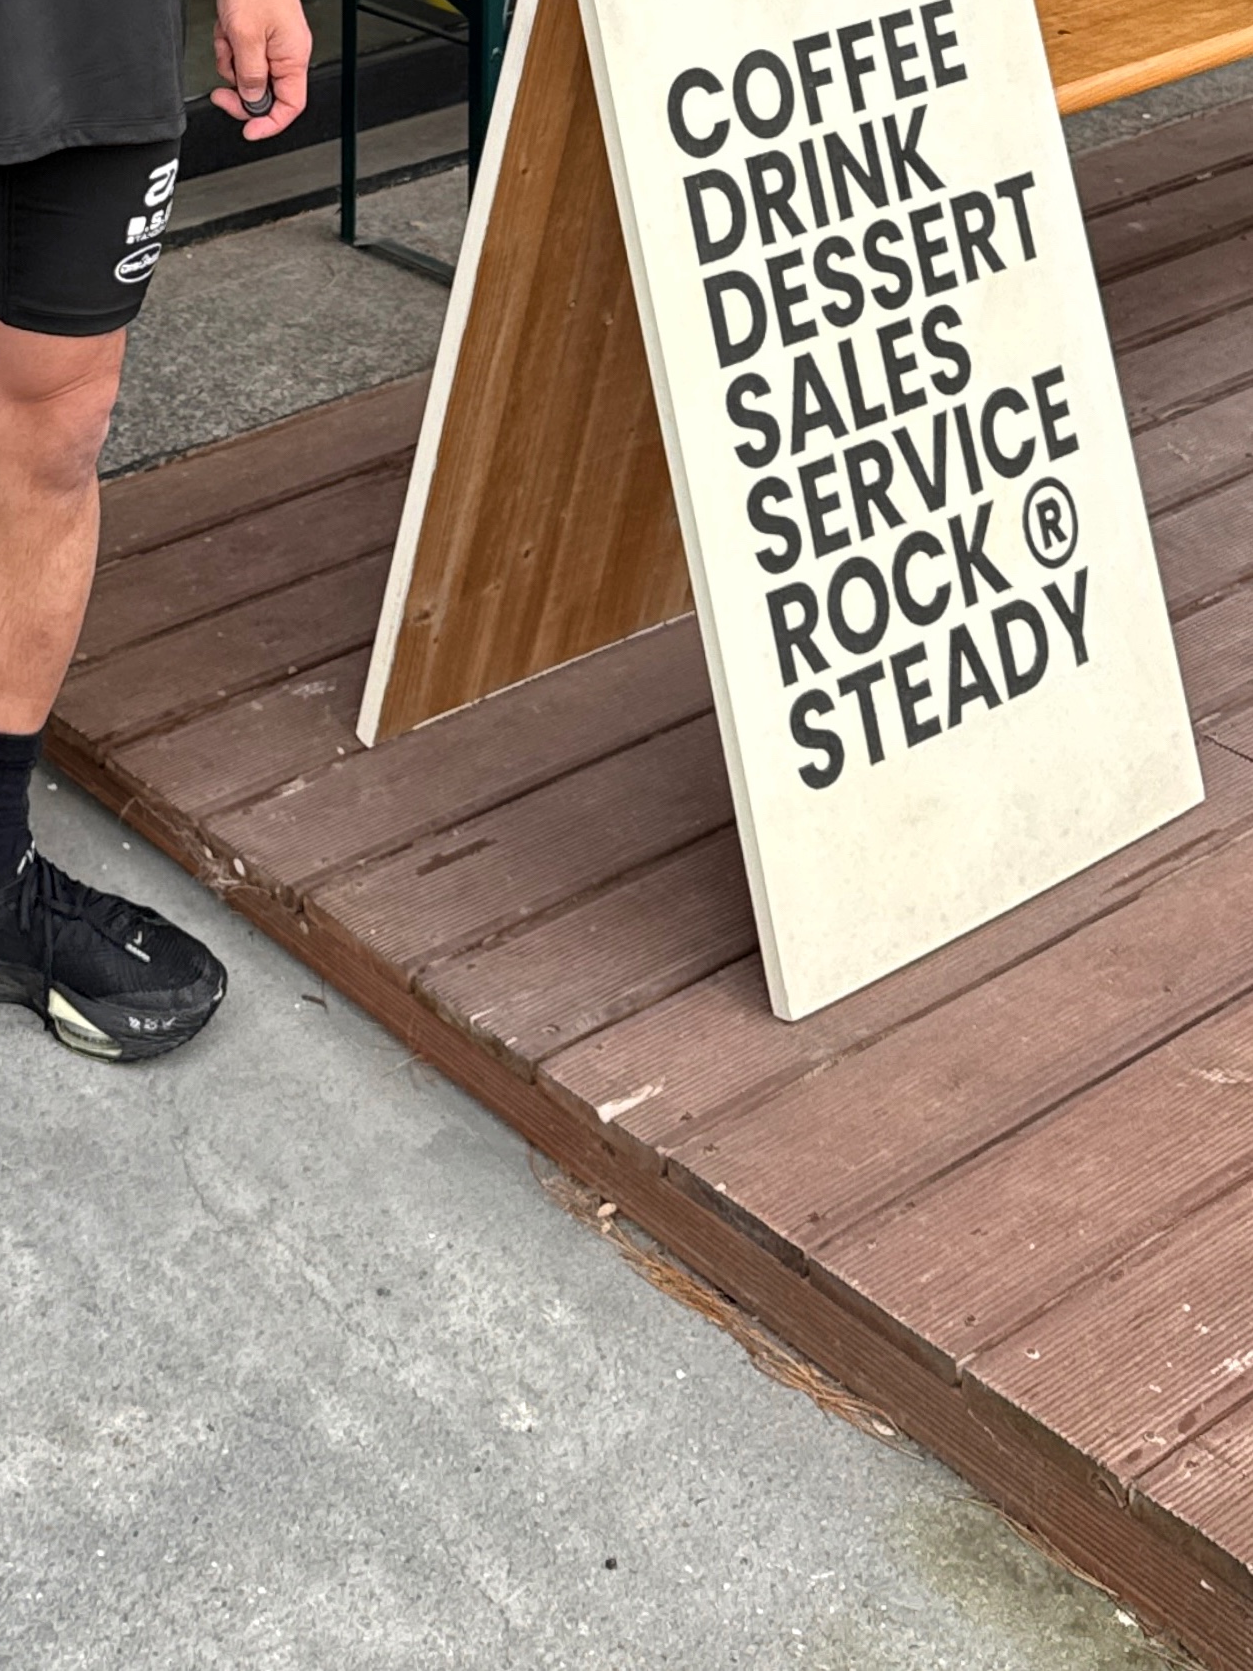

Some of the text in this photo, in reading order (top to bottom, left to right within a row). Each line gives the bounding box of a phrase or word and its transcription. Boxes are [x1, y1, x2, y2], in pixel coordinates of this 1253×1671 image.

[683, 104, 946, 265] DRINK
[703, 171, 1037, 369] DESSERT
[726, 304, 972, 469] SALES
[746, 366, 1079, 574] SERVICE
[765, 501, 1013, 687] ROCK
[790, 567, 1089, 790] STEADY
